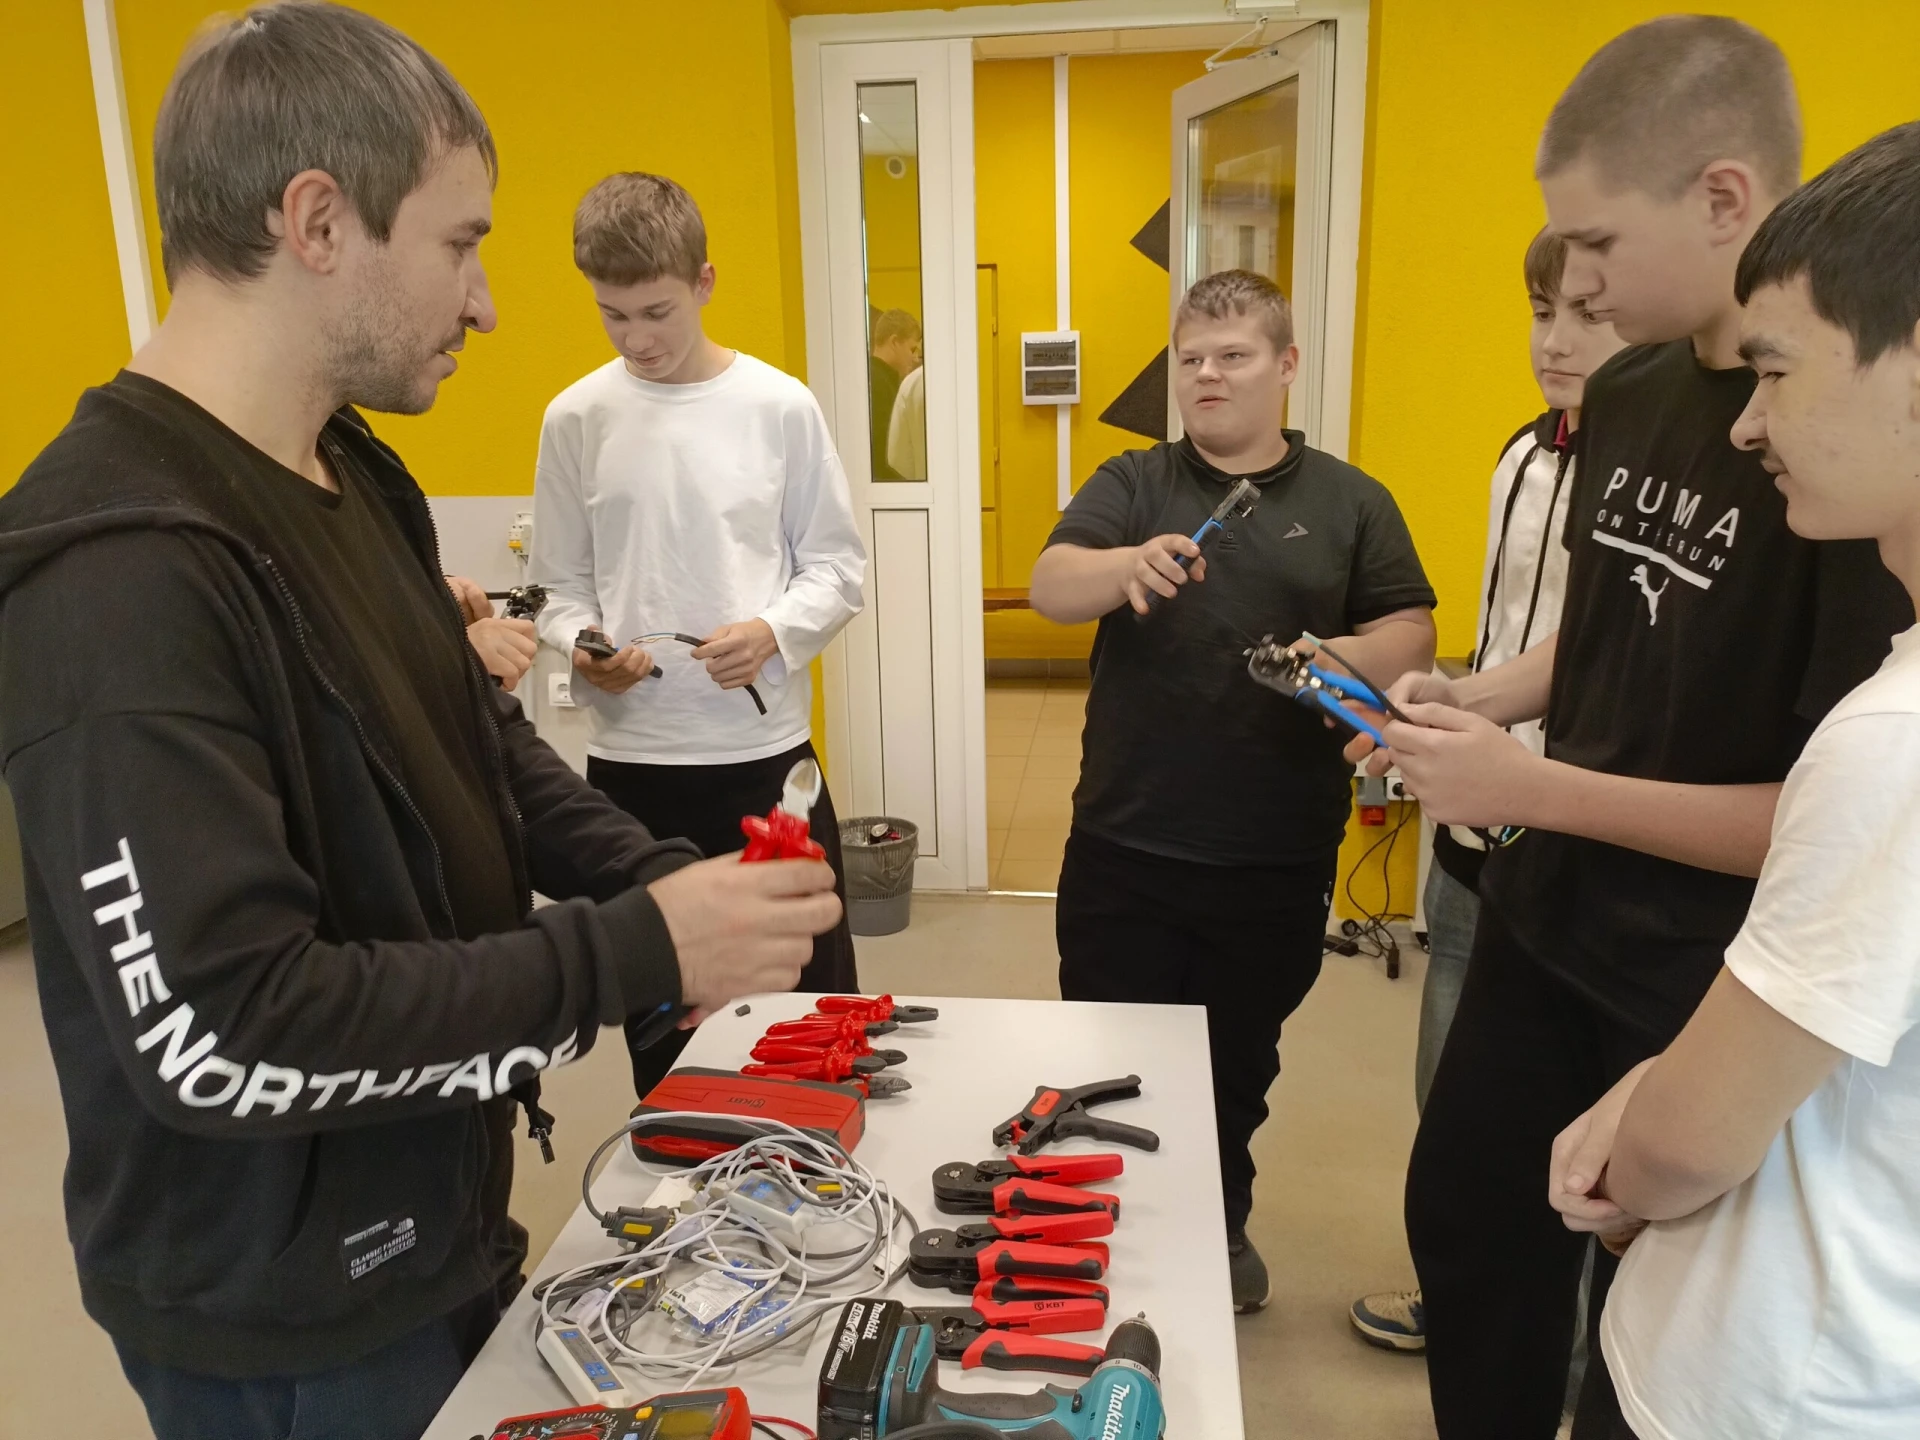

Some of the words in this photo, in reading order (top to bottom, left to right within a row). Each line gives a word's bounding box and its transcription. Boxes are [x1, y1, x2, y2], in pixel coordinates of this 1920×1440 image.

[1596, 509, 1623, 529] ON
[1676, 539, 1726, 571] RUN
[1603, 467, 1740, 548] PUMA
[81, 837, 173, 1018] THE
[135, 1002, 414, 1118] NORTH
